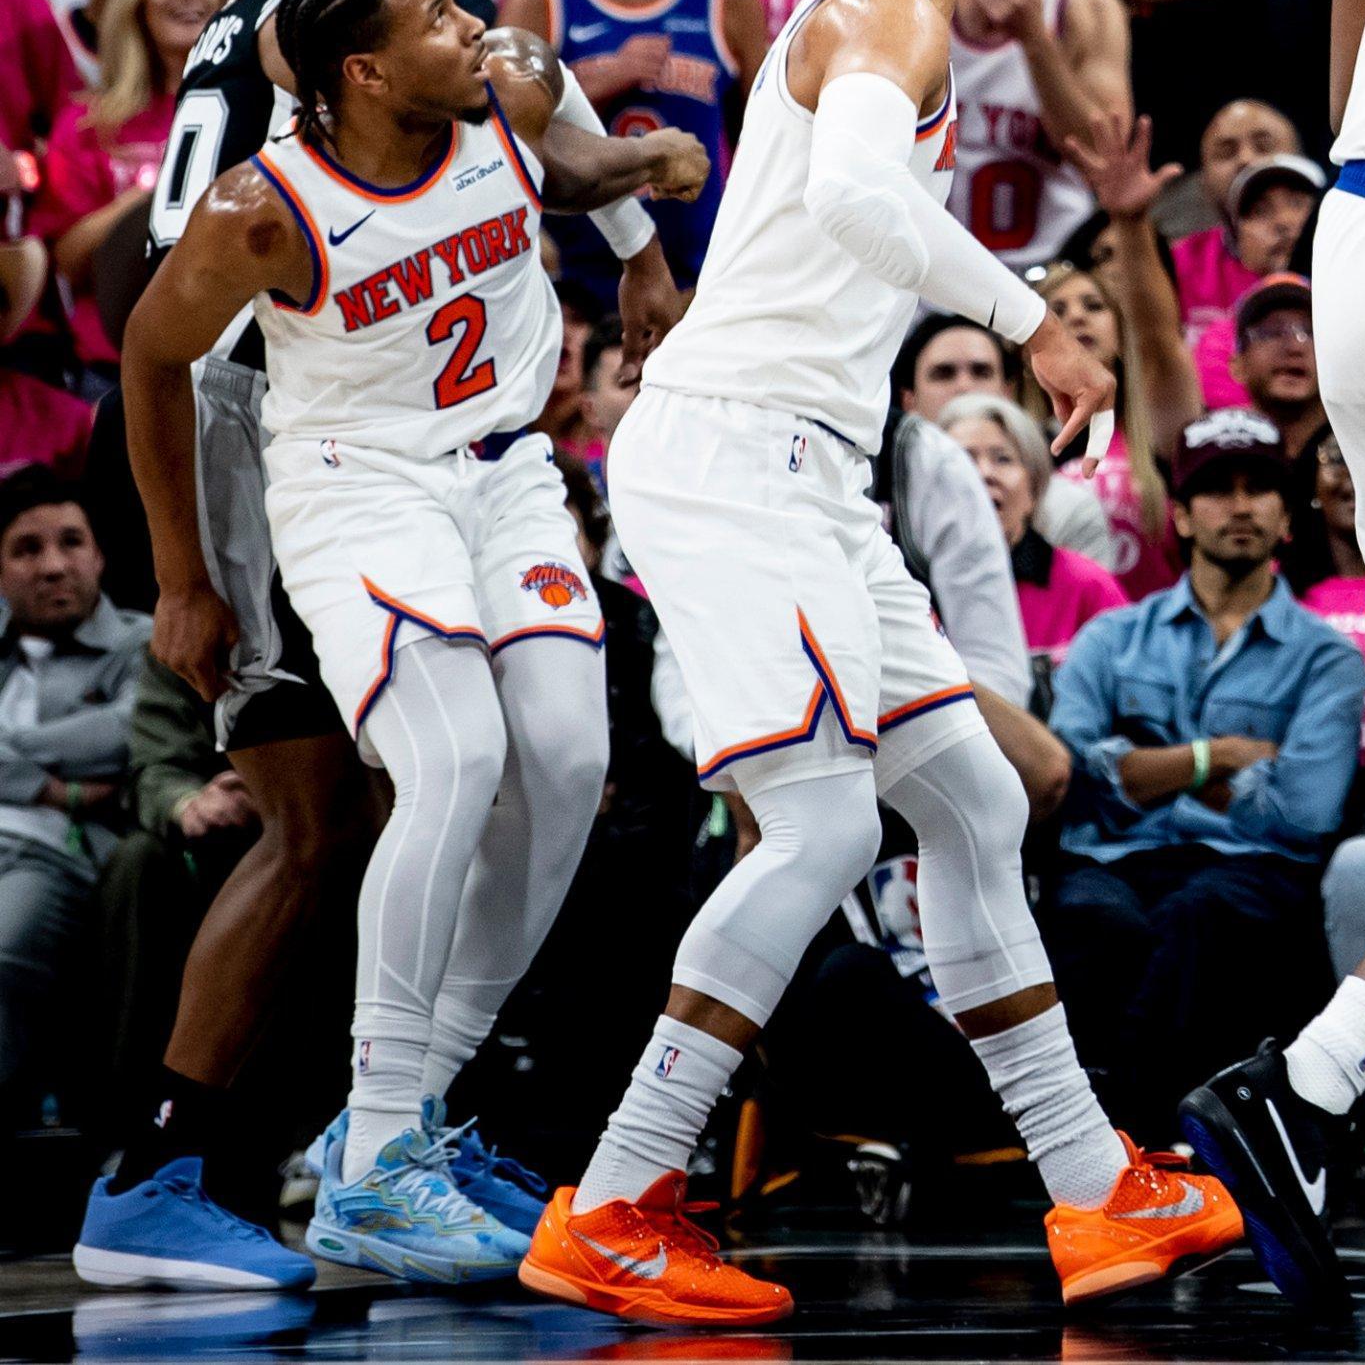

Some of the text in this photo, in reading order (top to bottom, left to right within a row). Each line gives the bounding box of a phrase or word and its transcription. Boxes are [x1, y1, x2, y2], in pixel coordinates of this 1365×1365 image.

[333, 206, 531, 333] NEW YORK
[425, 292, 498, 411] 2
